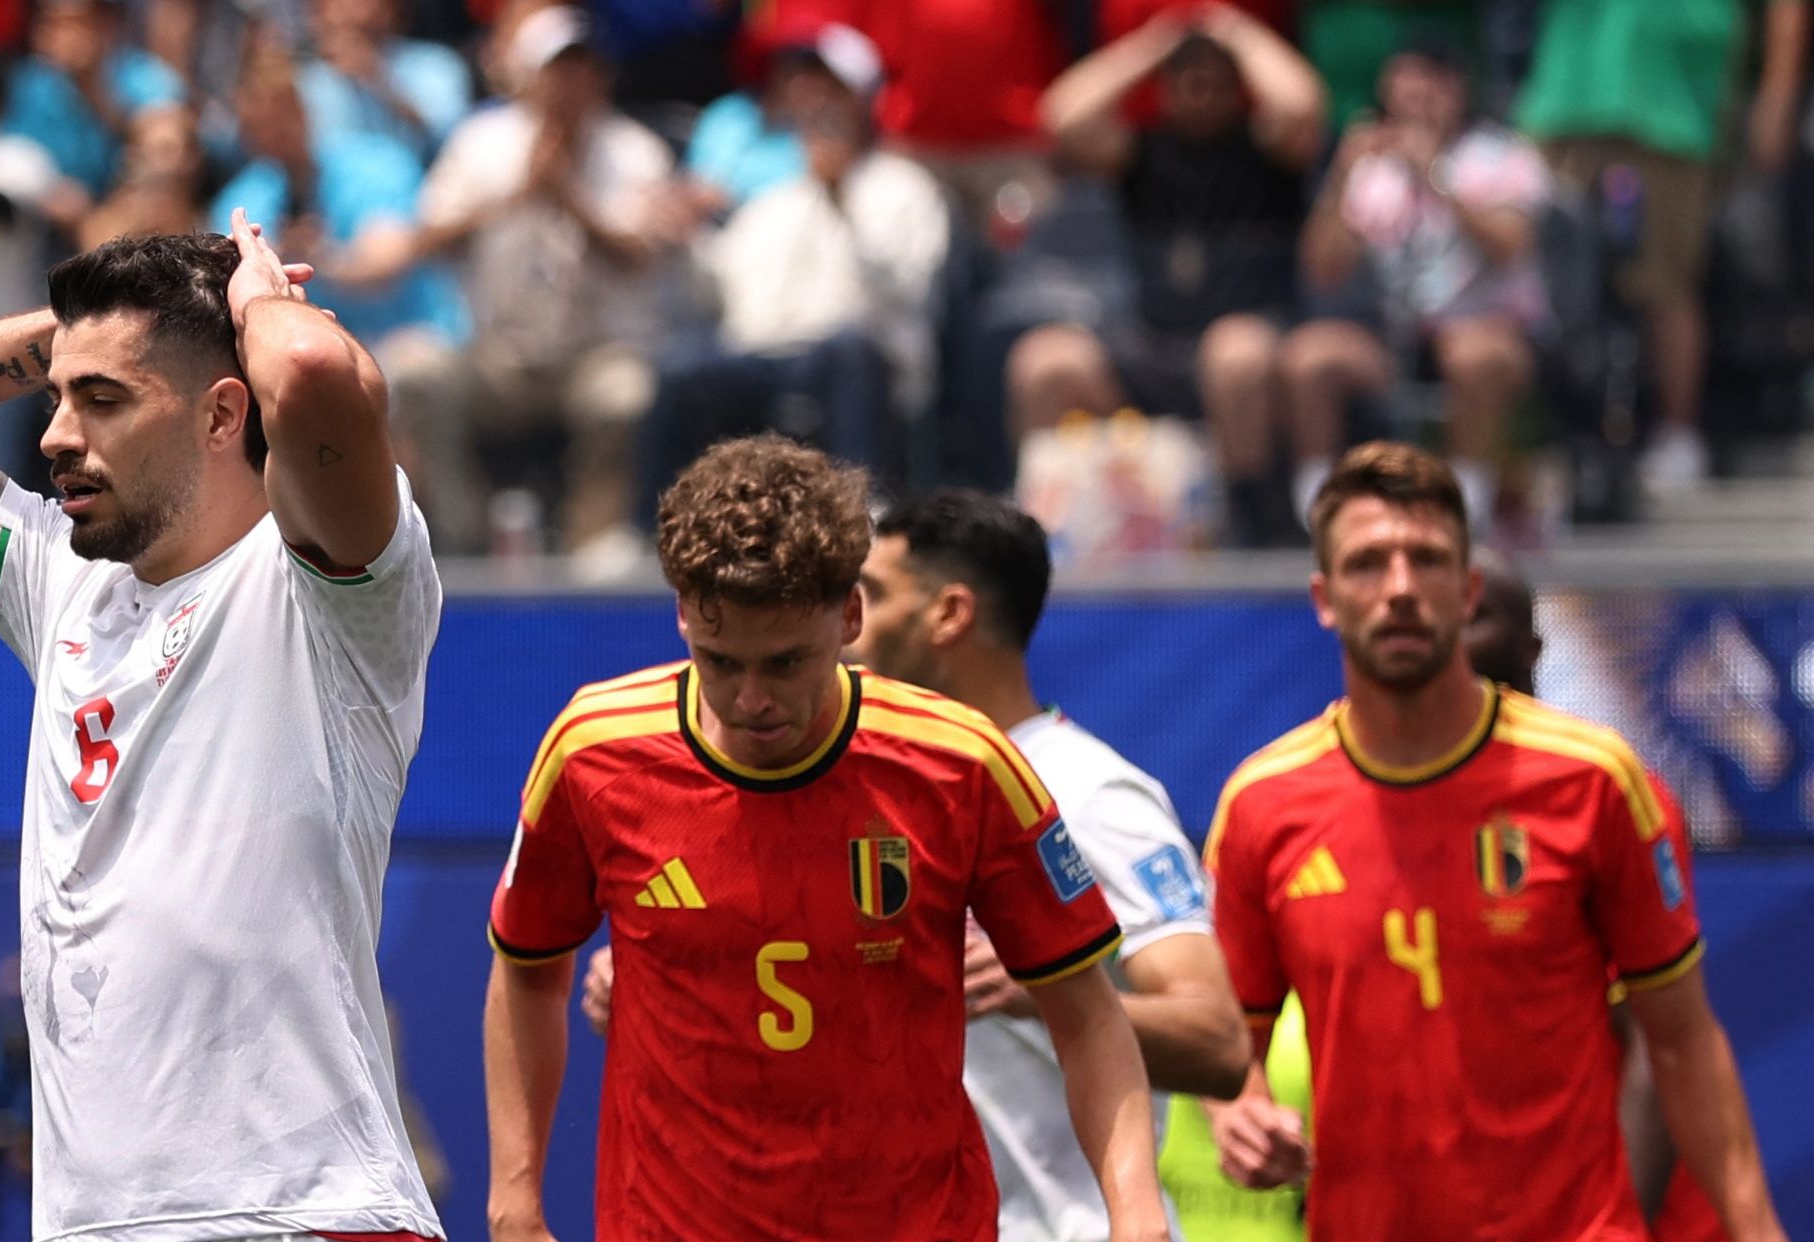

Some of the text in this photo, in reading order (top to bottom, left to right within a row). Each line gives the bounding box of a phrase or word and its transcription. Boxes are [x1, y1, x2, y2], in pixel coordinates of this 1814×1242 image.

[70, 696, 119, 803] 6
[755, 942, 814, 1052] 5
[1384, 907, 1443, 1010] 4
